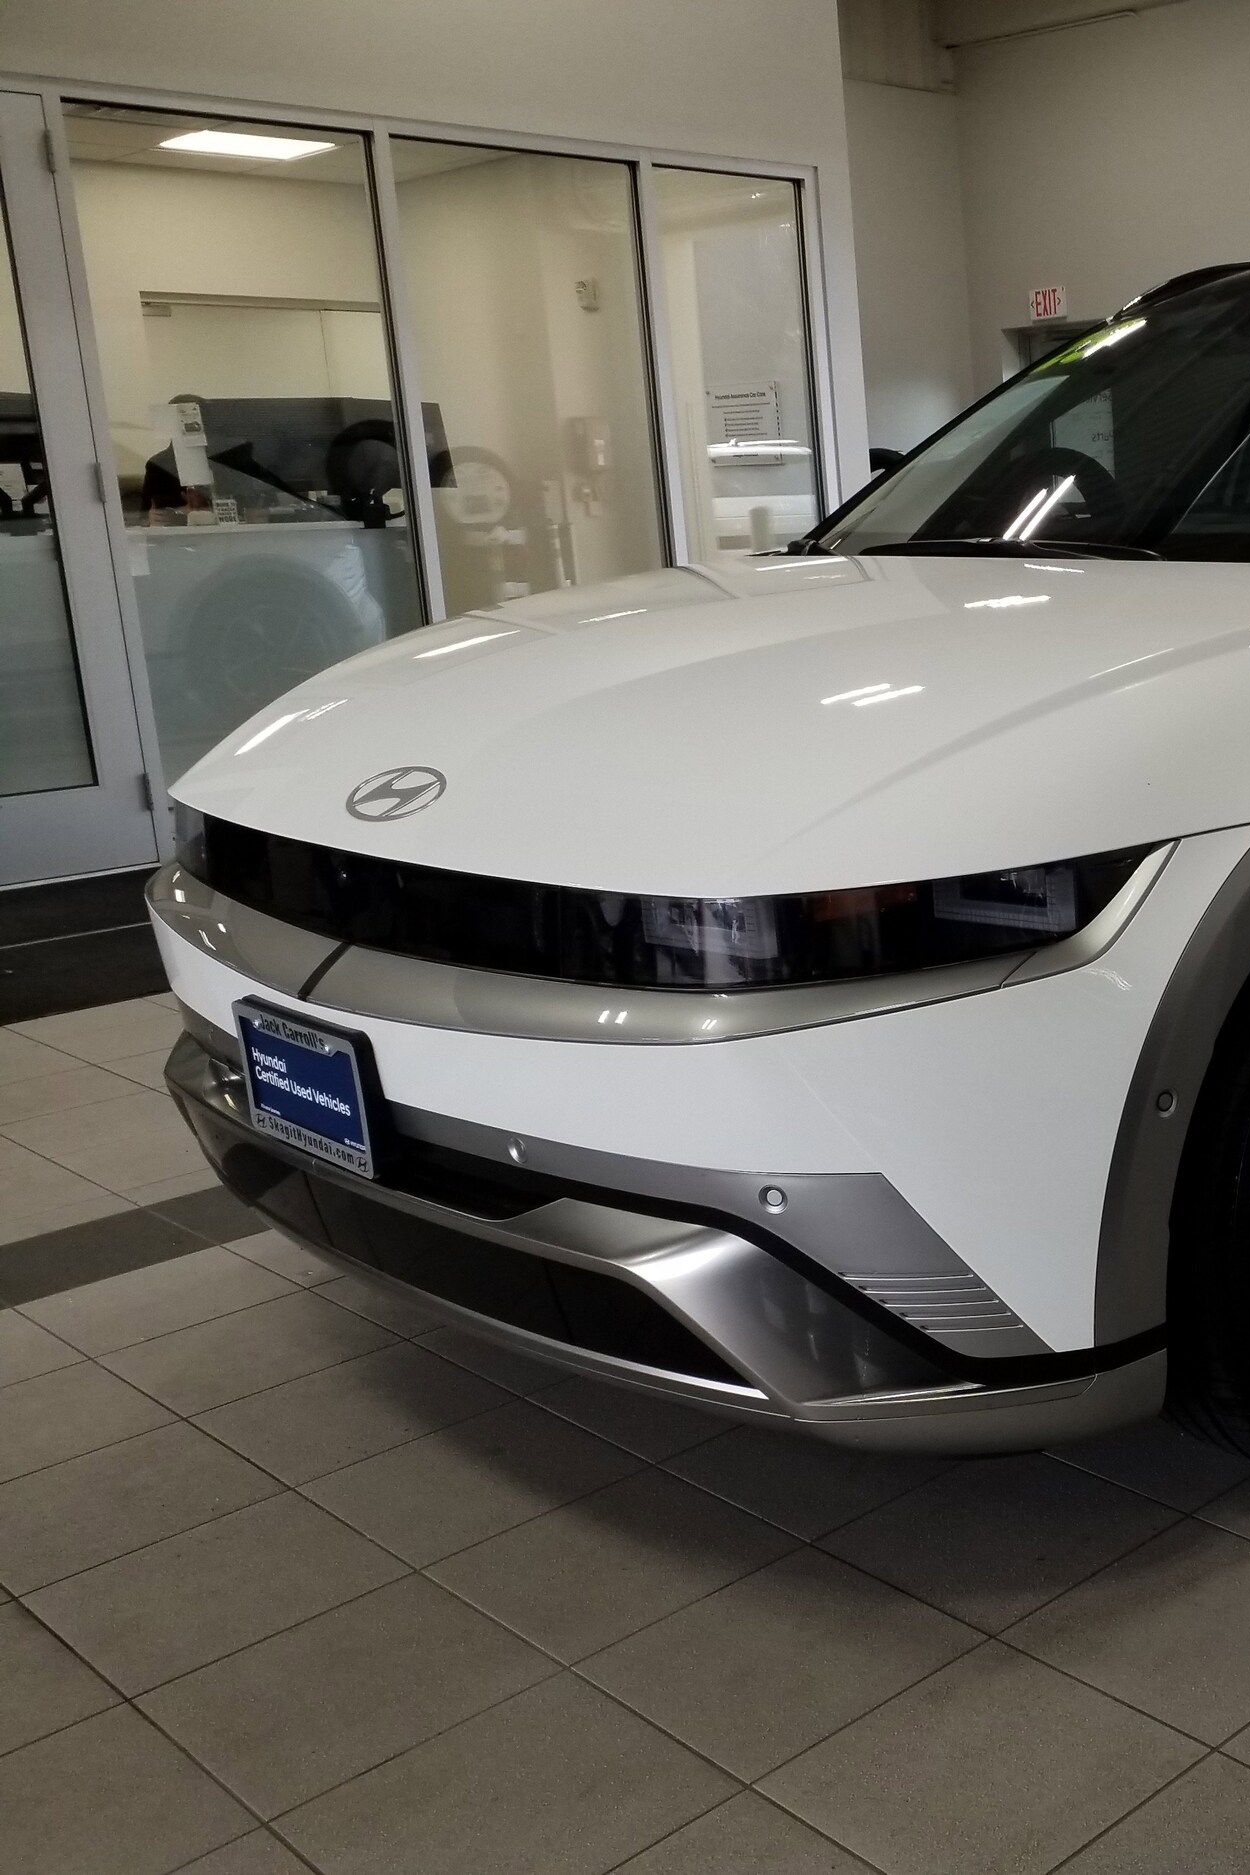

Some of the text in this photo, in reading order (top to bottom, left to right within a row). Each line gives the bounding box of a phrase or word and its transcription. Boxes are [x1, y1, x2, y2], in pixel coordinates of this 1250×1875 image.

[1034, 288, 1057, 317] EXIT
[260, 1014, 325, 1050] Jack Carroll's
[251, 1046, 287, 1073] Hyundai
[255, 1065, 290, 1092] Certified
[290, 1080, 312, 1102] Used
[311, 1088, 351, 1116] Vehicles
[268, 1117, 355, 1165] SkagitHyundai.com
